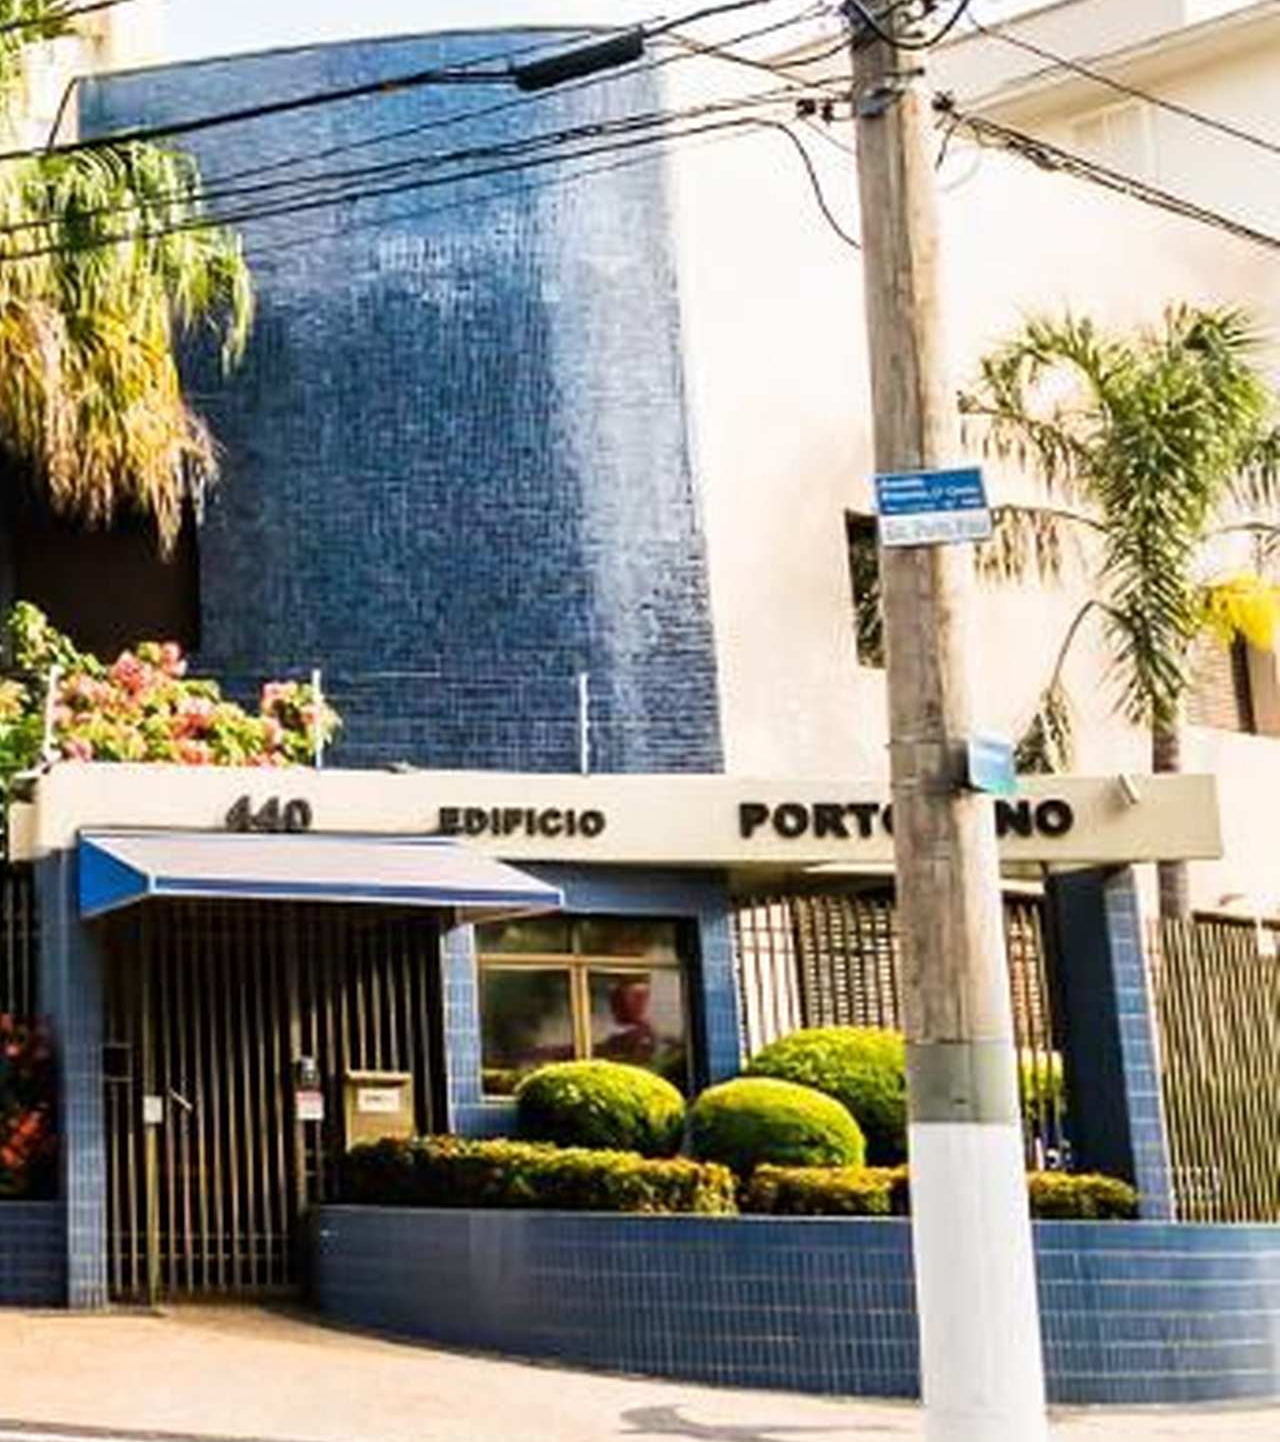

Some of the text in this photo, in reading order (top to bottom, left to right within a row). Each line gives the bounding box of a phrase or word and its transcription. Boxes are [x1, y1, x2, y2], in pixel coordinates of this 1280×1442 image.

[224, 795, 313, 832] 440
[438, 806, 606, 838] EDIFICIO
[738, 801, 893, 839] PORT
